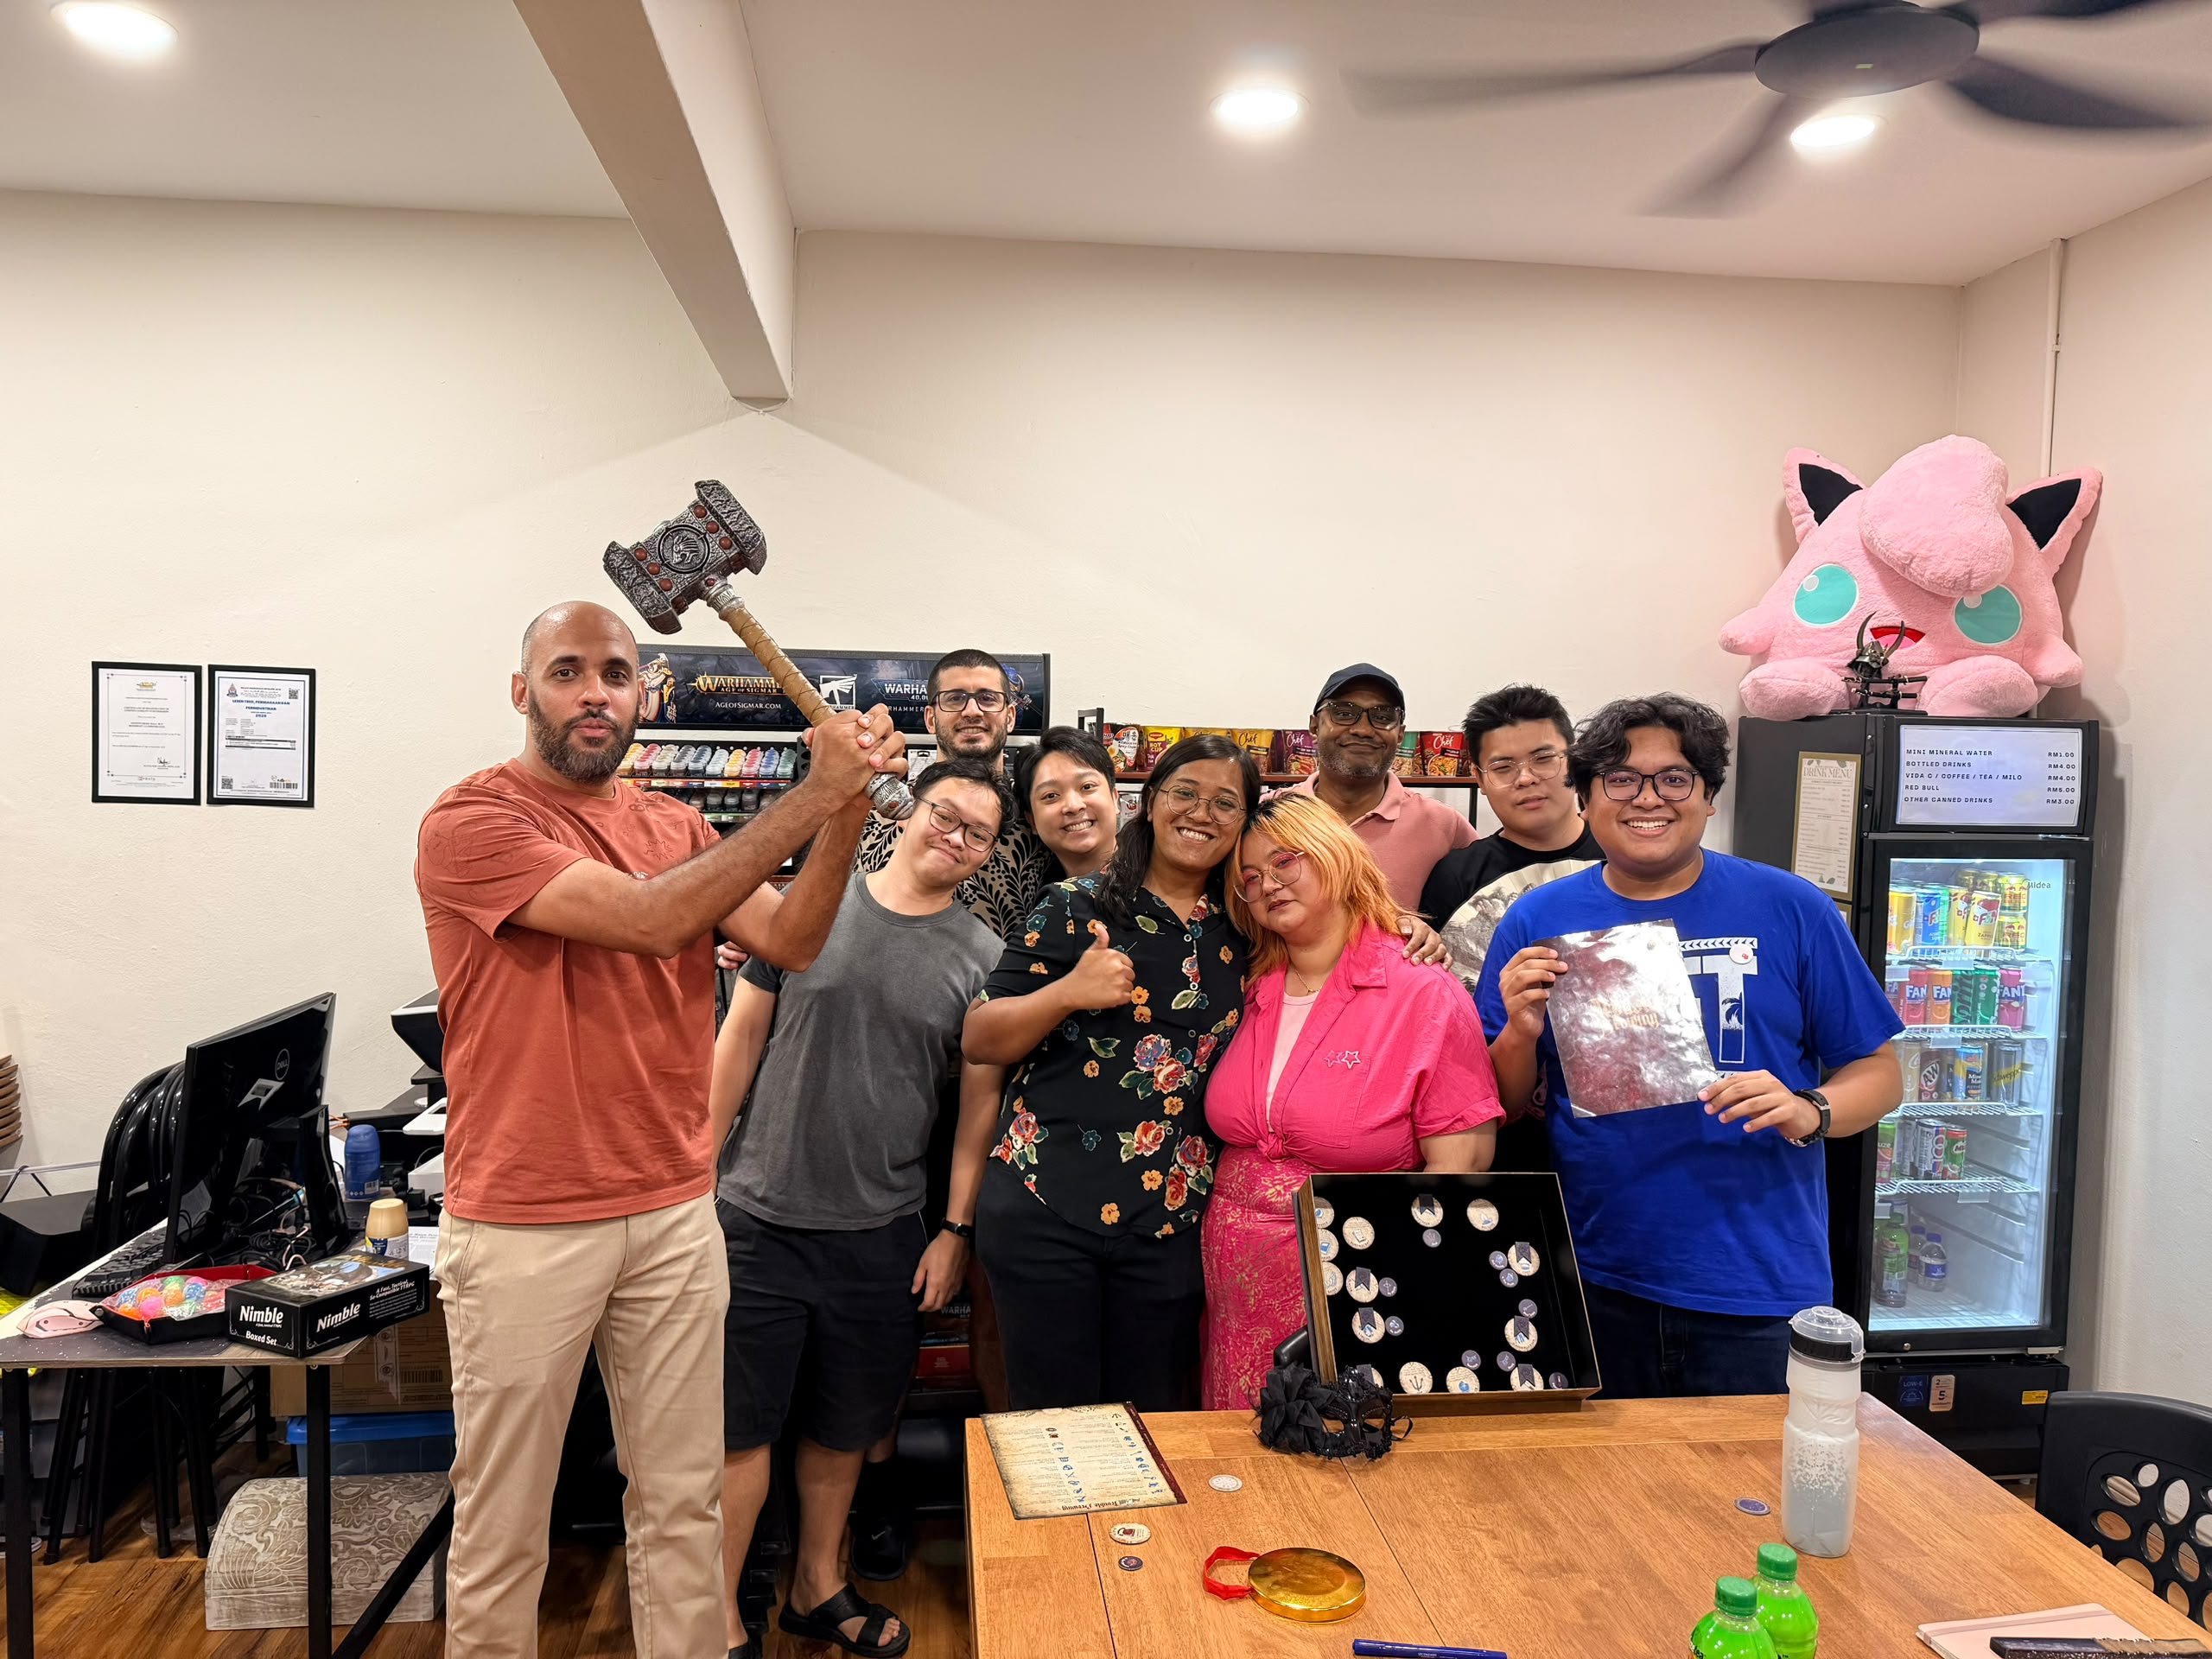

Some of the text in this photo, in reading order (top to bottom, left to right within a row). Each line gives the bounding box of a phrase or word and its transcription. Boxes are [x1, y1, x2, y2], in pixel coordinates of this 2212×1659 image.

[884, 683, 927, 694] WARHA
[1239, 733, 1258, 747] Chef
[1287, 734, 1305, 747] Chef
[1433, 735, 1453, 749] Chef
[1803, 767, 1853, 779] DRINK MENU
[1905, 985, 1927, 998] FAN
[1933, 985, 1952, 998] FAN
[1999, 985, 2024, 998] FANT
[276, 1058, 289, 1071] DELL
[239, 1306, 284, 1324] Nimble
[941, 1306, 971, 1314] WARHA
[316, 1302, 361, 1333] Nimble
[245, 1330, 277, 1346] Boxed Set
[1938, 1390, 1946, 1400] 5
